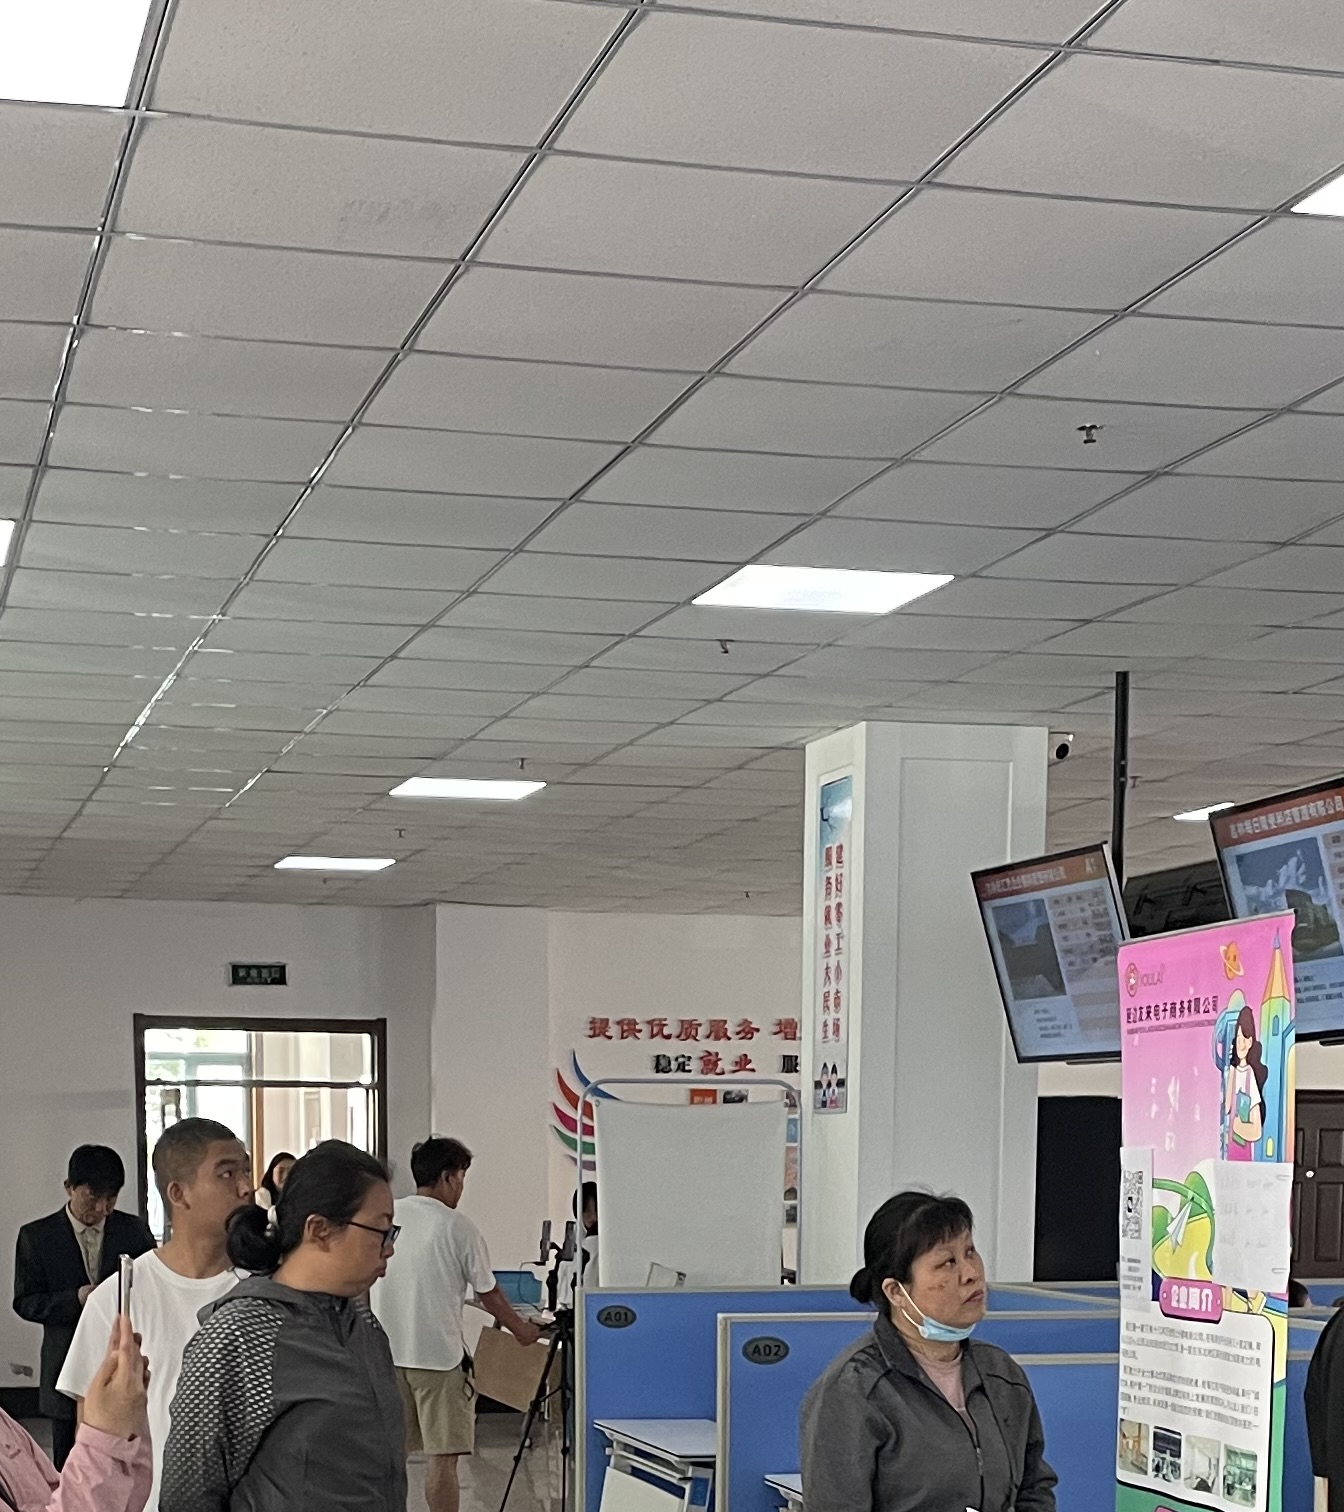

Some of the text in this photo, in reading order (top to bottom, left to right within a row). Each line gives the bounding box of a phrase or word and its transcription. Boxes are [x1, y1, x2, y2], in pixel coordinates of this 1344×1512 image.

[588, 1017, 760, 1041] 提供优质服务
[654, 1050, 756, 1076] 稳定就业
[603, 1310, 629, 1322] A01
[751, 1344, 781, 1357] A02
